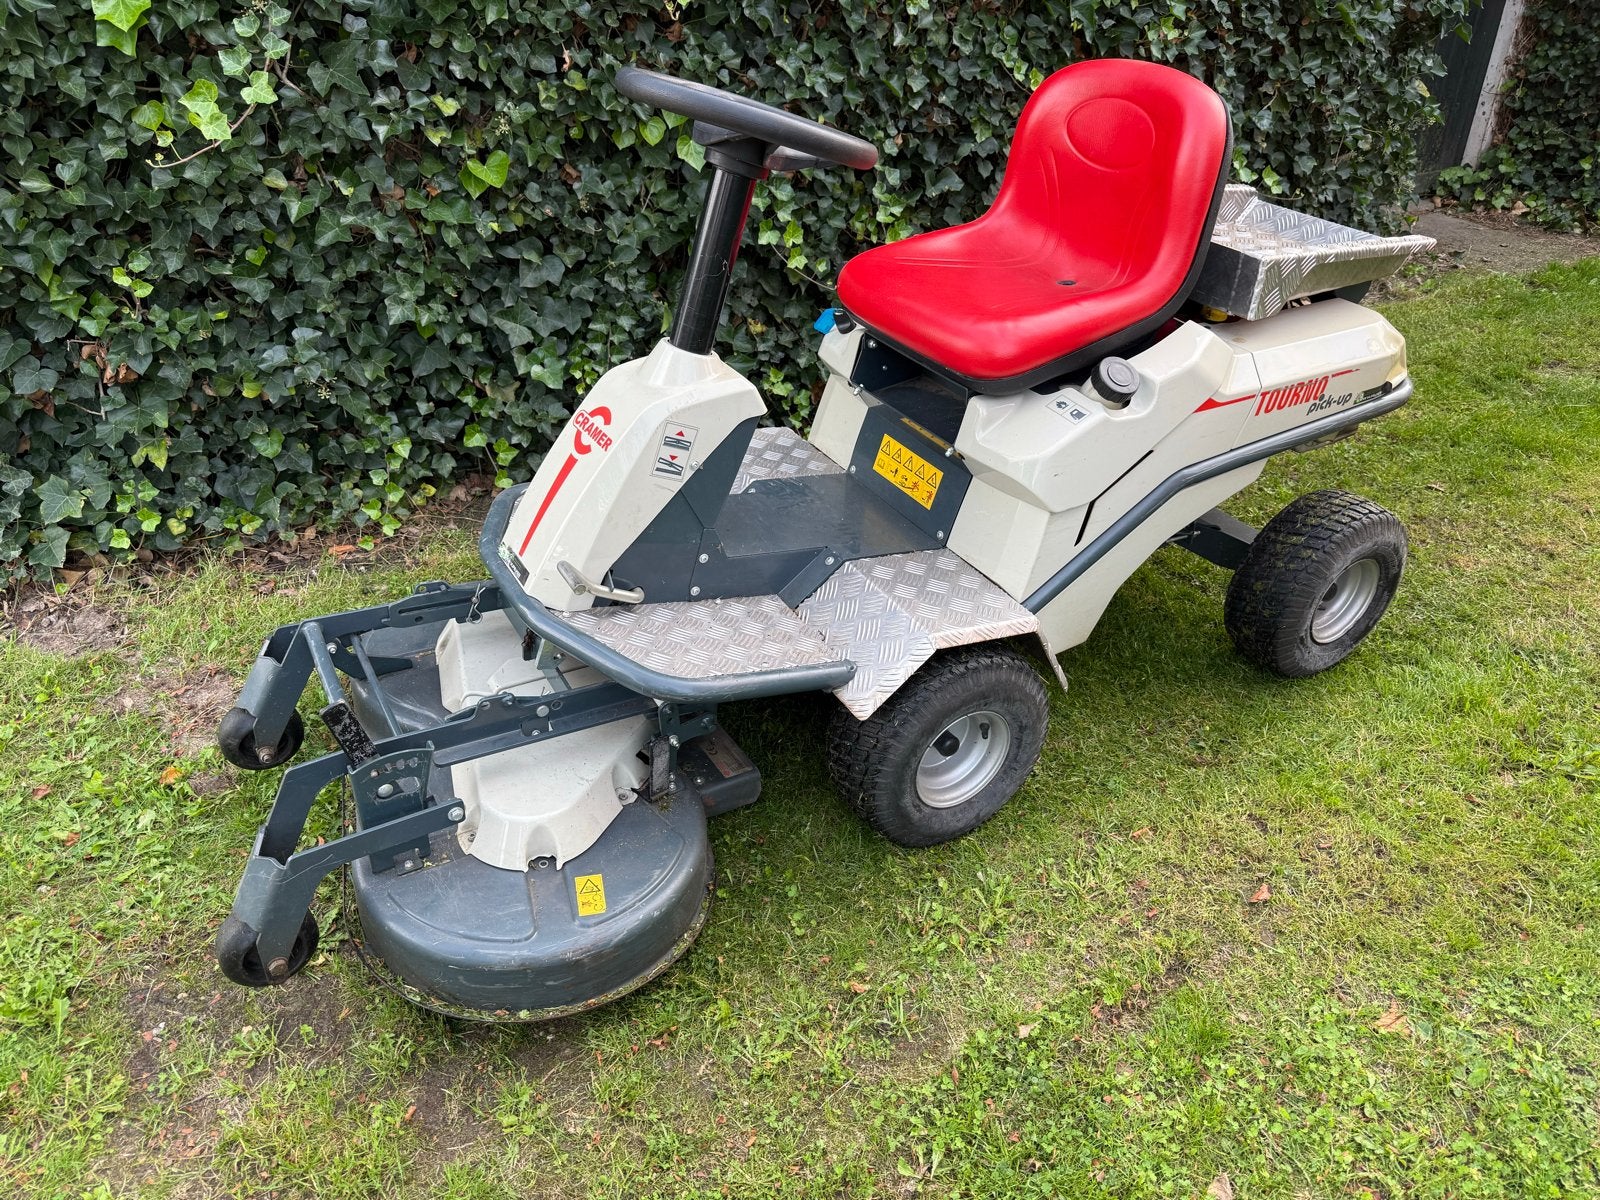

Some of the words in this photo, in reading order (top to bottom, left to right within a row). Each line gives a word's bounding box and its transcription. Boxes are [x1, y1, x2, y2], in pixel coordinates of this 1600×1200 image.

[1255, 376, 1329, 416] TOURNO
[1306, 392, 1353, 416] pick-up
[574, 412, 613, 452] CRAMER
